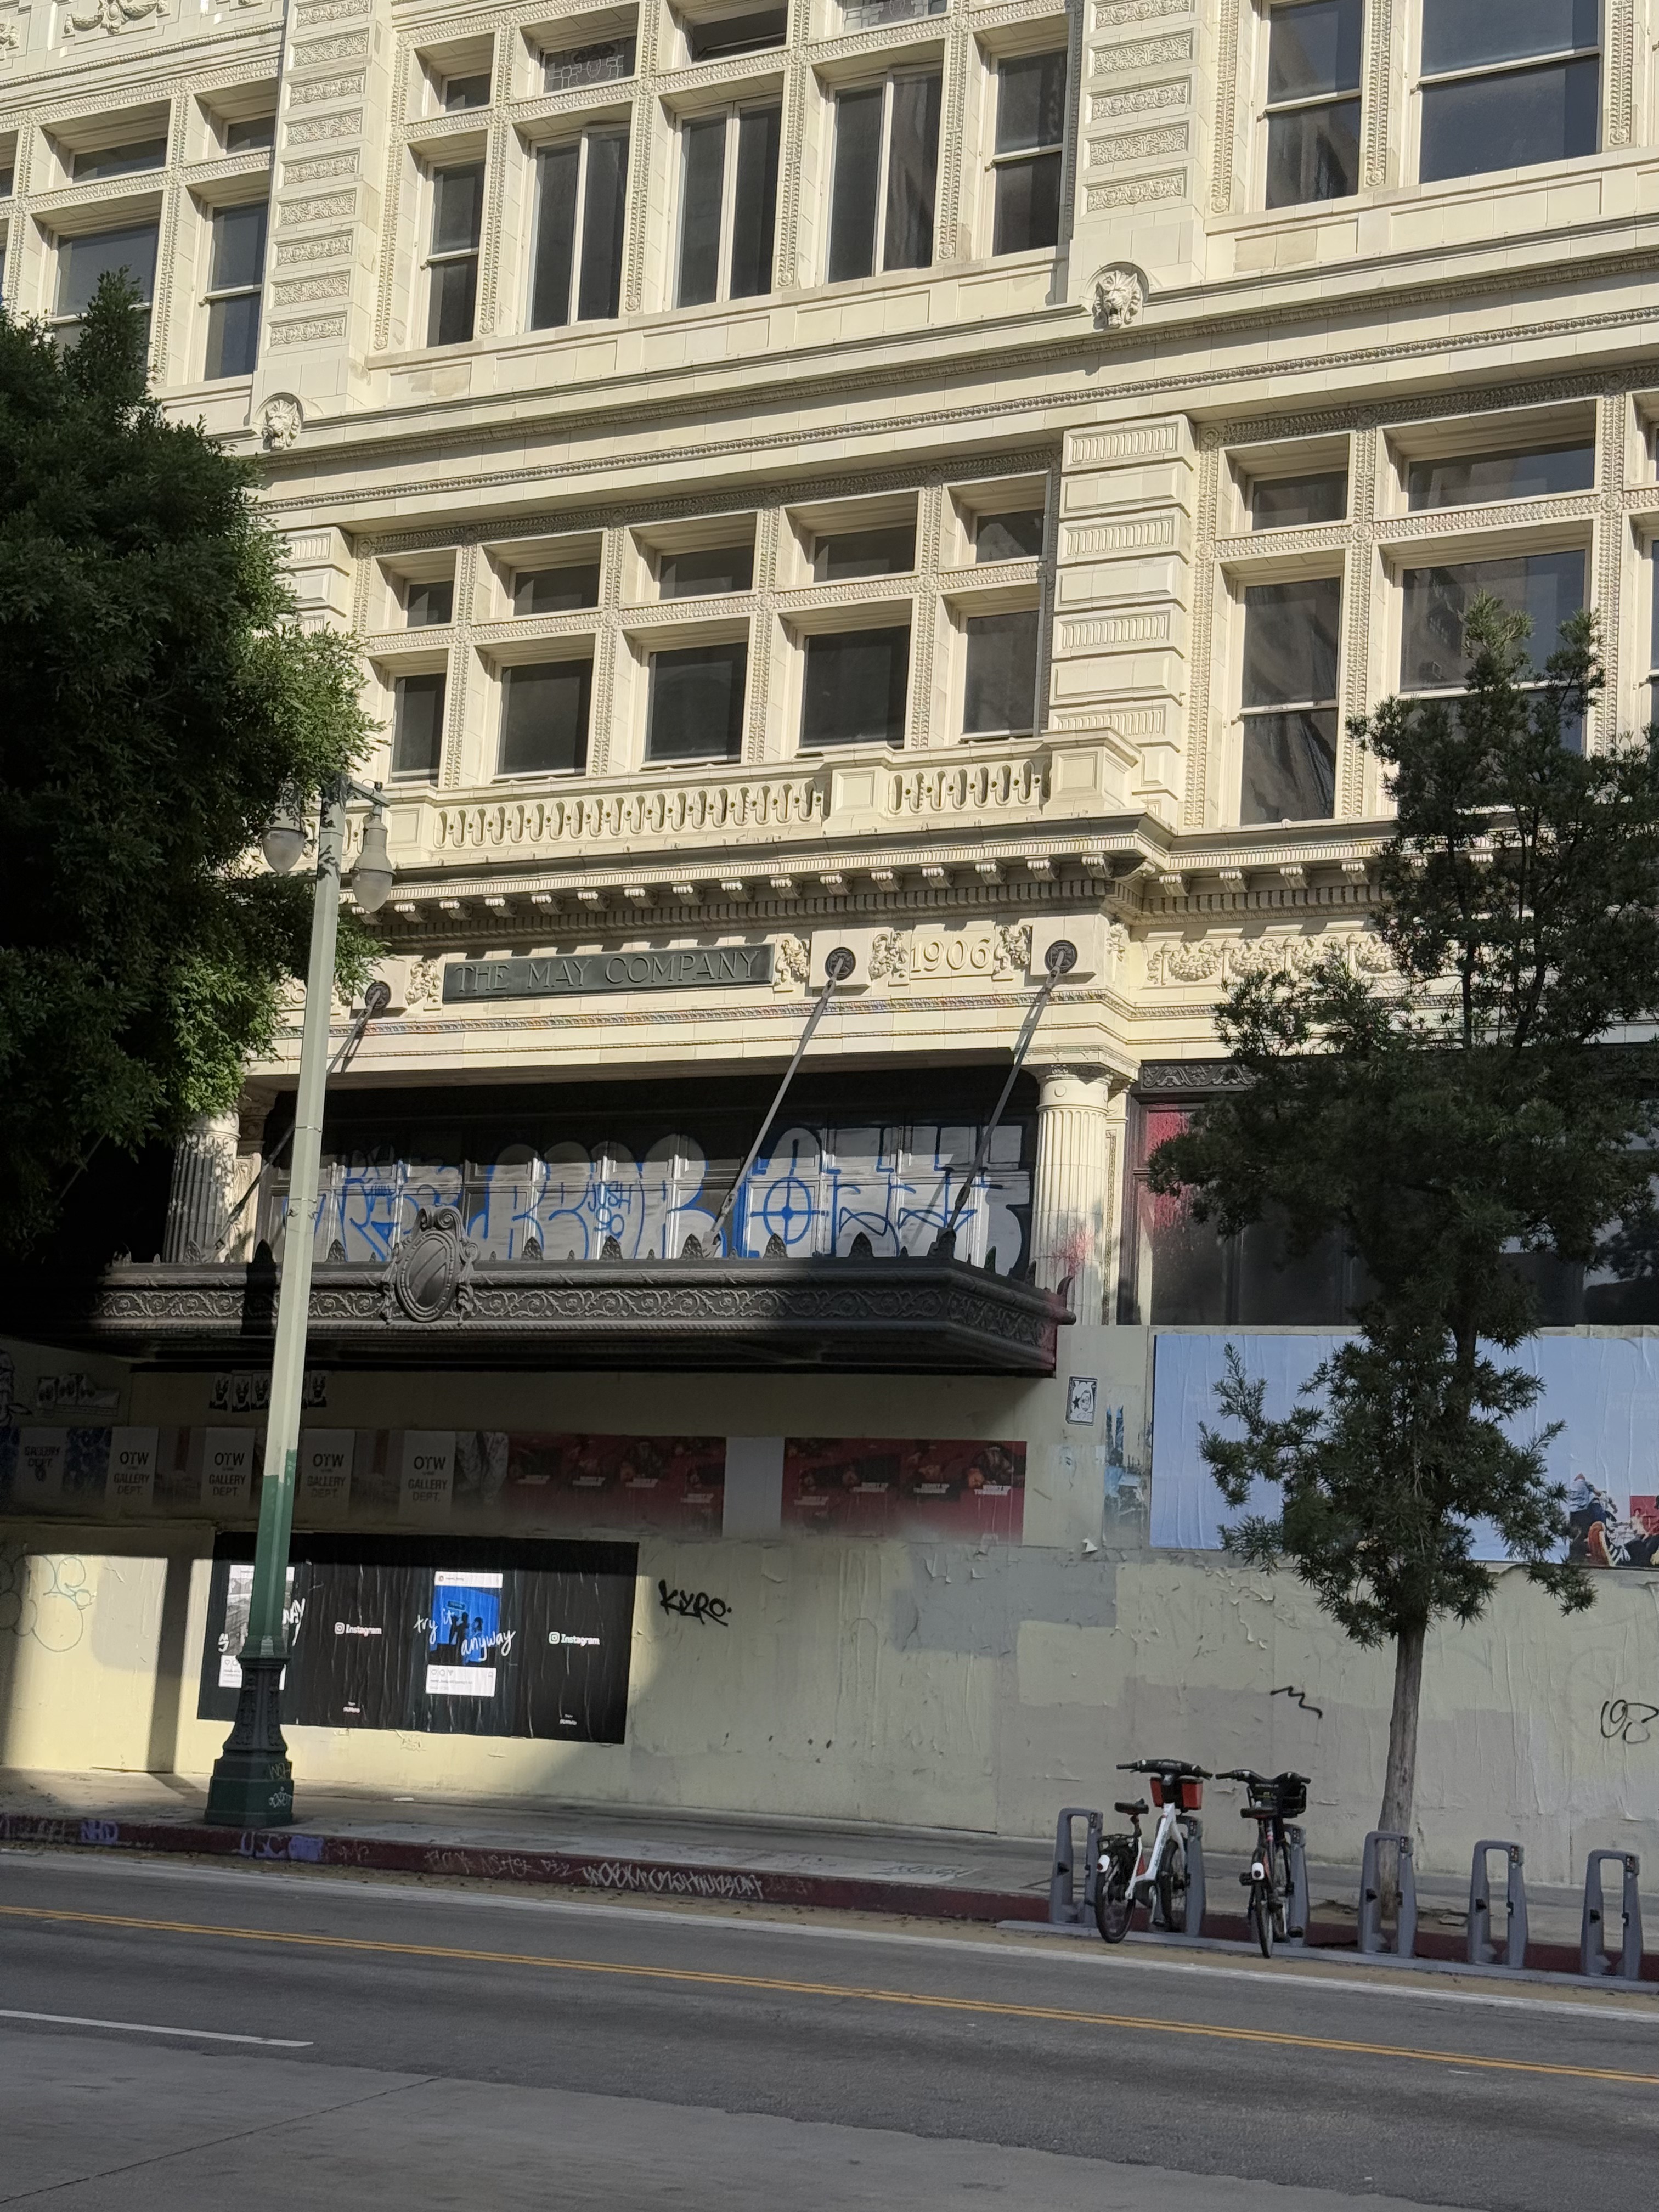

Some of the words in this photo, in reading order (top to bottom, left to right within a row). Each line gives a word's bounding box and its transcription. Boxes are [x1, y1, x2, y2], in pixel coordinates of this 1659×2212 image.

[911, 937, 991, 973] 1906
[455, 964, 509, 993] THE
[527, 960, 592, 988] MAY
[605, 951, 760, 984] COMPANY
[120, 1452, 149, 1465] OTW
[214, 1452, 244, 1466] OTW
[313, 1453, 344, 1468] OTW
[414, 1456, 446, 1470] OTW
[114, 1473, 149, 1485] GALLERY
[209, 1475, 246, 1486] GALLERY
[408, 1479, 447, 1491] GALLERY
[346, 1624, 382, 1637] Instagram
[413, 1614, 438, 1645] try
[442, 1608, 455, 1626] it
[461, 1630, 516, 1661] anyway
[561, 1633, 600, 1647] Instagram
